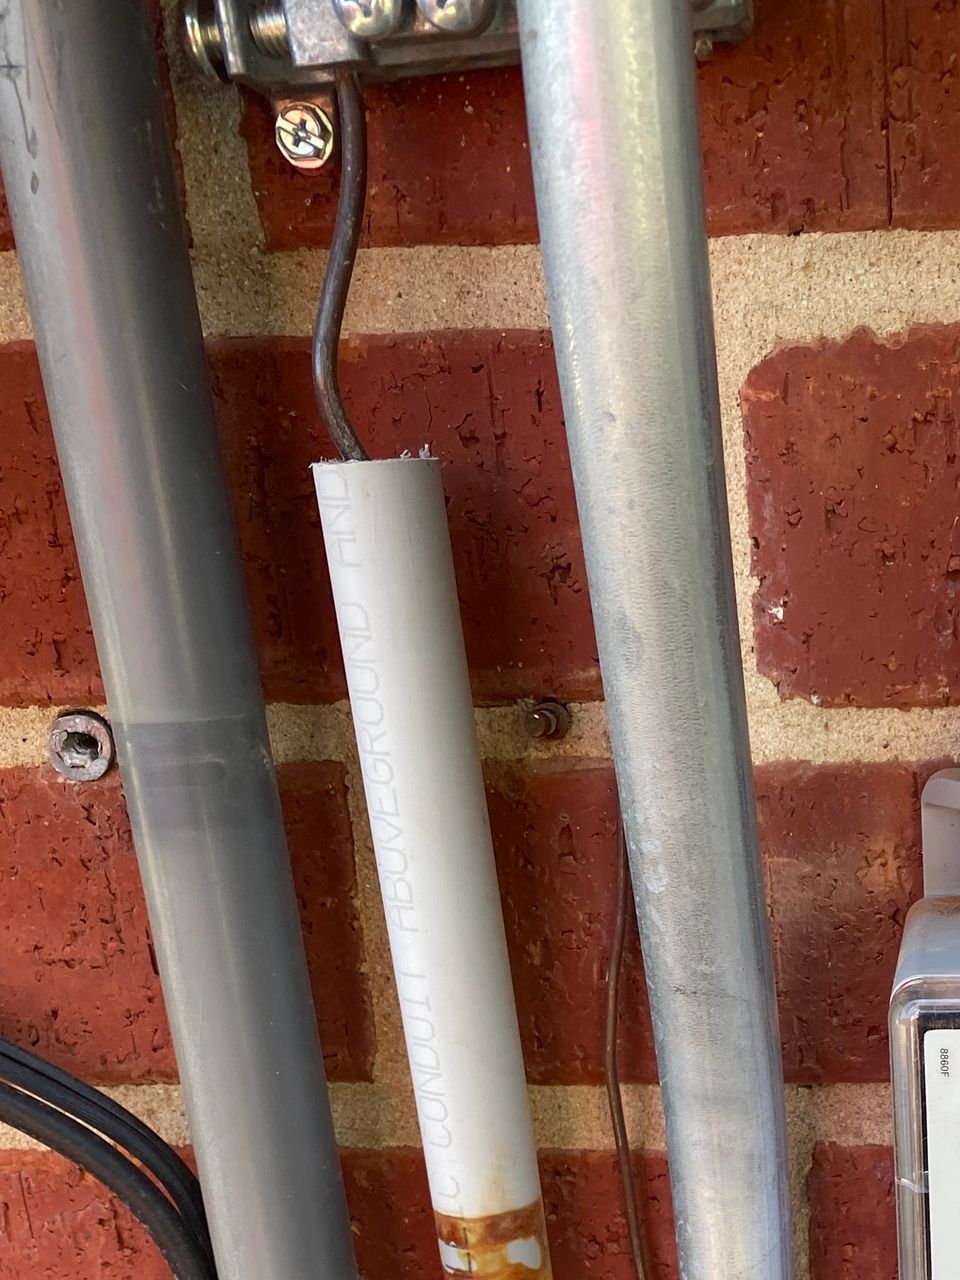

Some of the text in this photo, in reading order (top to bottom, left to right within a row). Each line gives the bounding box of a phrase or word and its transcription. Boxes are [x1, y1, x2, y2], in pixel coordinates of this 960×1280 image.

[325, 468, 363, 569] AND
[342, 602, 419, 933] ABOVEGROUND
[401, 971, 453, 1149] CONDUIT
[939, 1047, 949, 1077] 8860F
